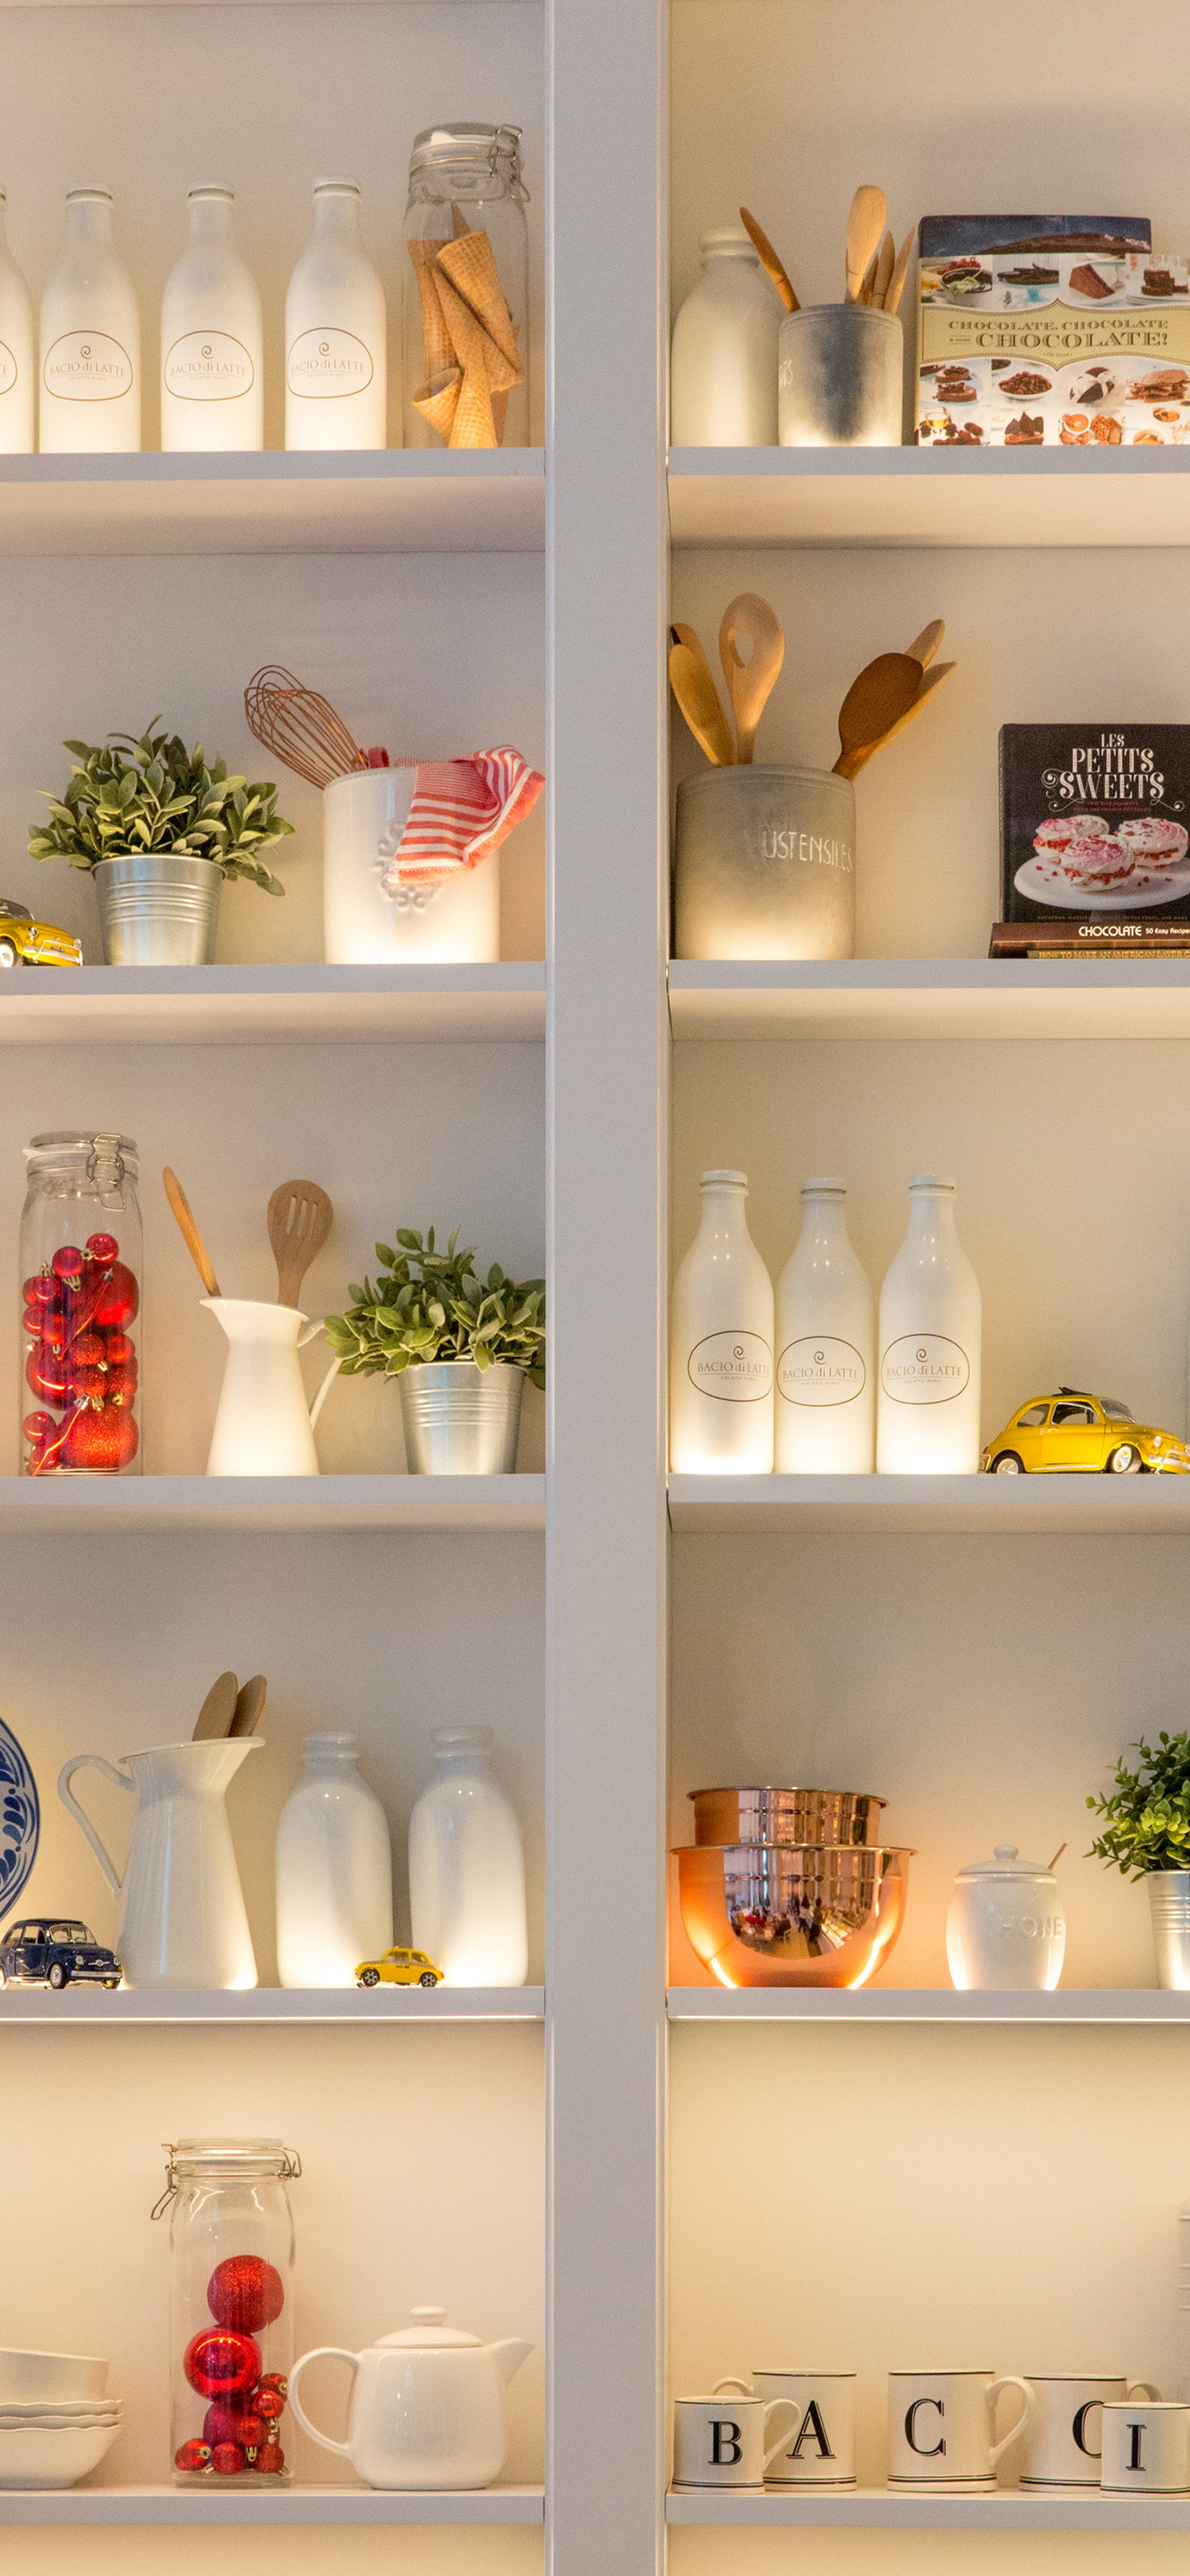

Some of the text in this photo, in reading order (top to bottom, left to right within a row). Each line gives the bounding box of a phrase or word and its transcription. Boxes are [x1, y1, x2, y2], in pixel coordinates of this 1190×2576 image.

[948, 319, 1168, 331] CHOCOLATE, CHOCOLATE
[975, 332, 1168, 348] CHOCOLATE!
[50, 362, 125, 377] BACIO di LATTE
[171, 362, 245, 377] BACIO di LATTE
[320, 358, 331, 369] di
[333, 358, 364, 373] LATTE
[1101, 733, 1125, 748] LES
[1072, 748, 1155, 773] PETITS
[1059, 770, 1164, 799] SWEETS
[763, 830, 853, 873] USTENSILES
[1079, 926, 1142, 937] CHOCOLATE
[698, 1362, 770, 1375] BACIO di LATTE
[783, 1368, 858, 1379] BACIO di LATTE
[886, 1366, 961, 1377] BACIO di LATTE
[1000, 1916, 1065, 1939] HONE
[786, 2400, 836, 2459] A
[904, 2398, 946, 2456] C
[707, 2421, 744, 2466] B
[1126, 2424, 1147, 2471] I
